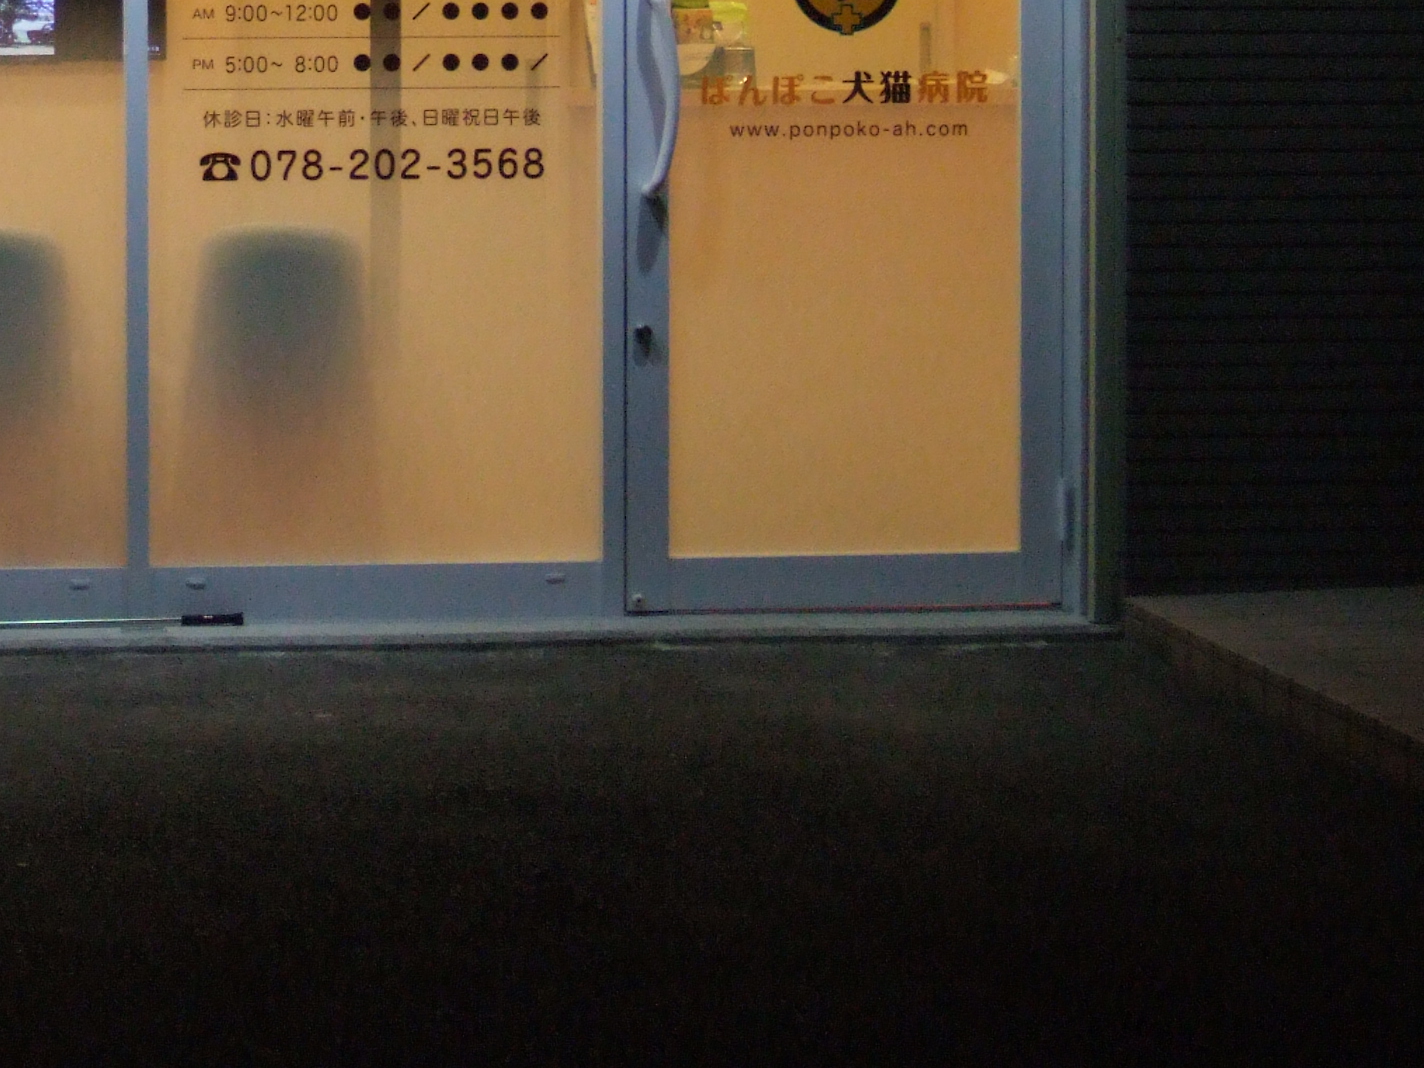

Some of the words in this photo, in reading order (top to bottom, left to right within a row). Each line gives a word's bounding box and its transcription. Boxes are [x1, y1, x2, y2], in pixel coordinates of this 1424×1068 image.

[192, 8, 215, 20] AM
[192, 58, 215, 70] PM
[701, 70, 989, 106] ぽんぽこ犬猫病院
[729, 121, 969, 140] www.ponpoko-ah.com
[250, 147, 546, 182] 078-202-3568
